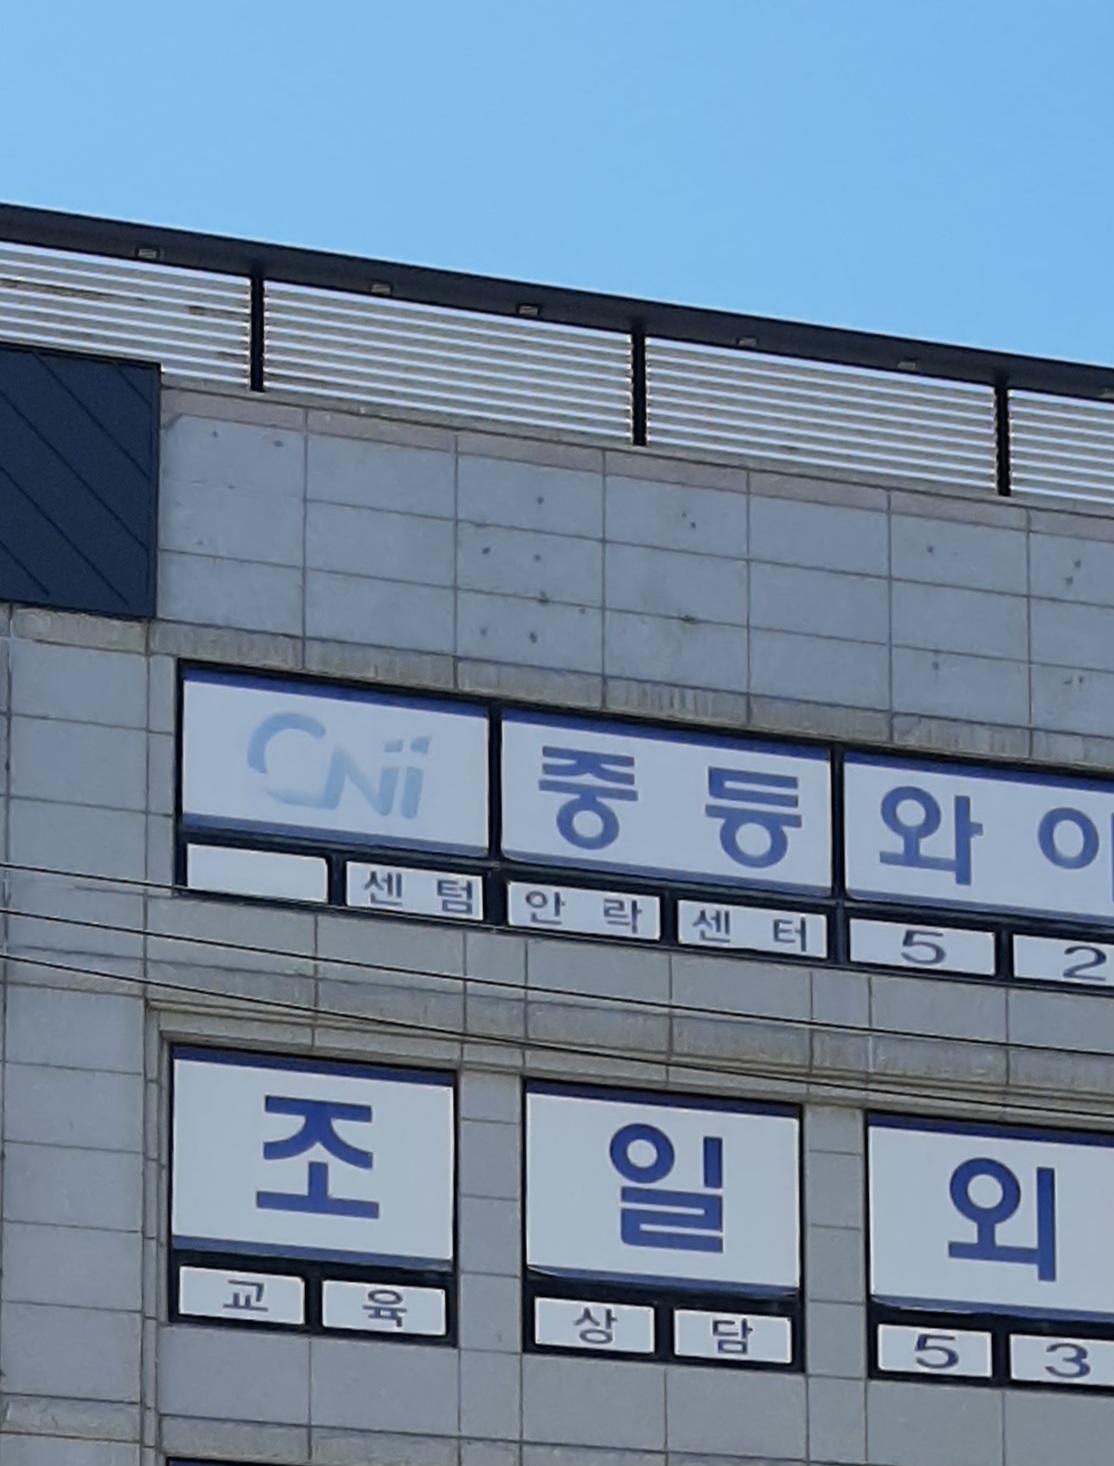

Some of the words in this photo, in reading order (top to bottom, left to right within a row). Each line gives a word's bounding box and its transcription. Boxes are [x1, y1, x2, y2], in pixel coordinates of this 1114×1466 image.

[538, 745, 803, 869] 중등
[222, 1280, 407, 1328] 교육
[574, 1307, 753, 1355] 상담
